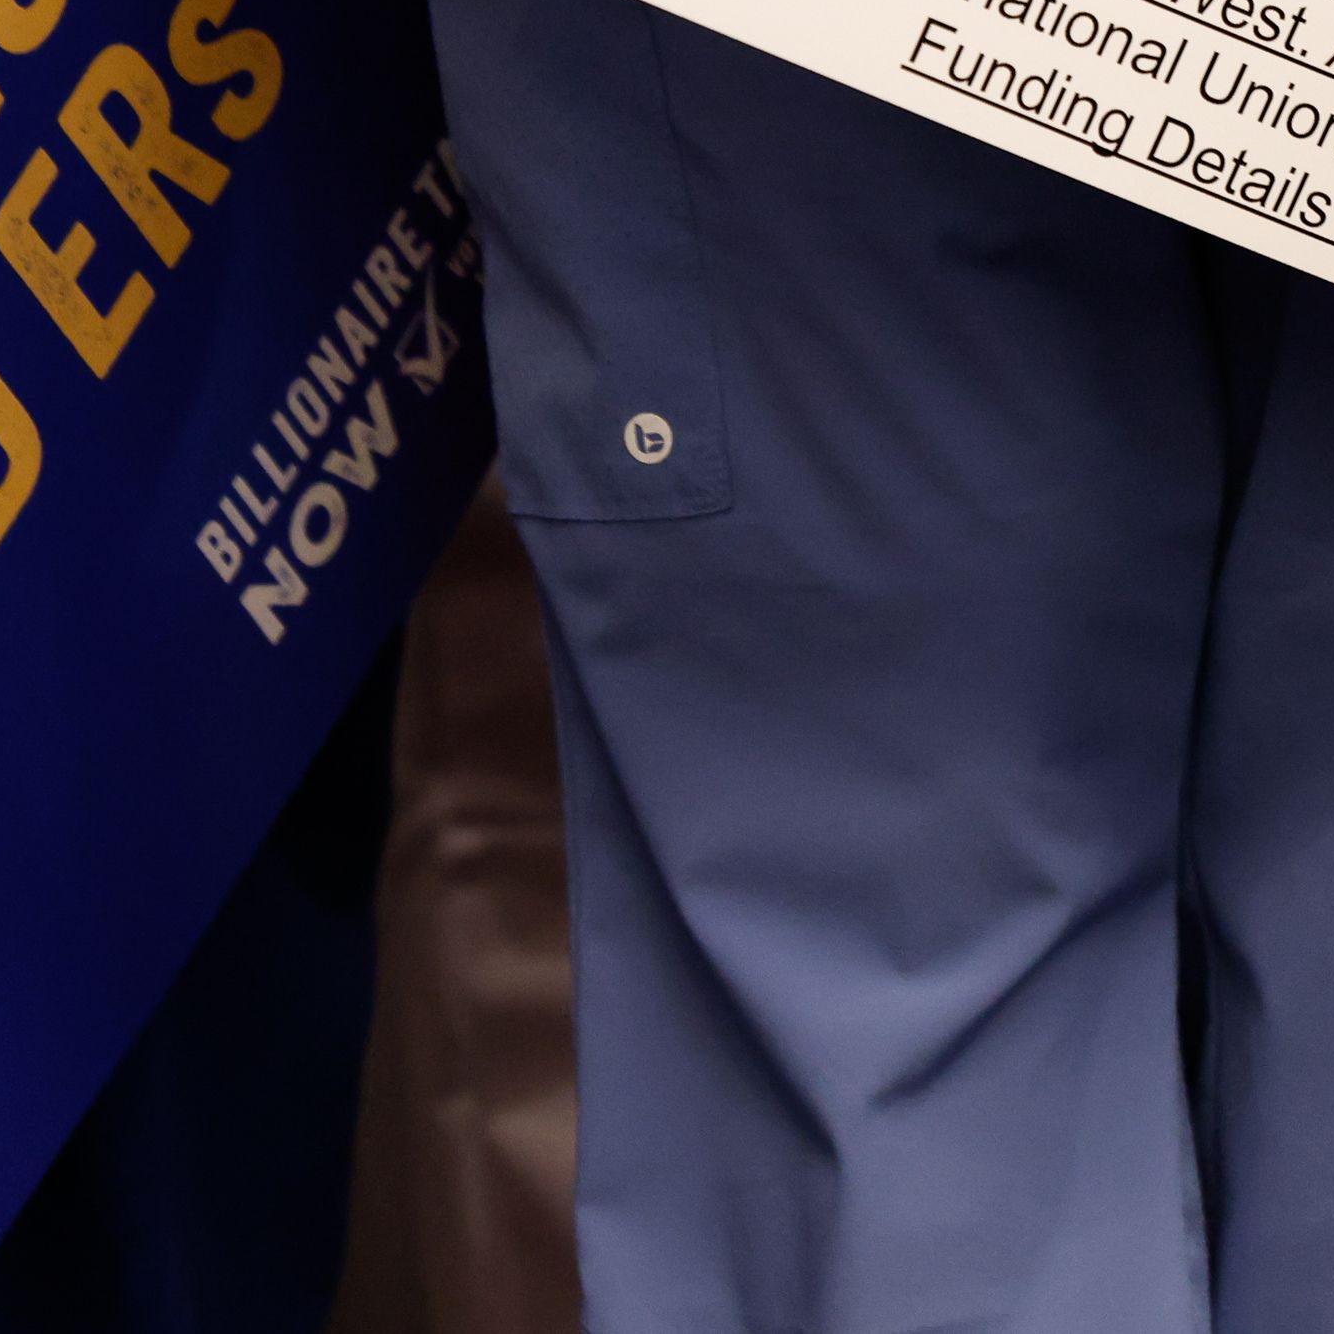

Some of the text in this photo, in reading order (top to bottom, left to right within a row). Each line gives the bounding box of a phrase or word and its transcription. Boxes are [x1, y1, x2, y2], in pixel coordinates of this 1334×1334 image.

[909, 18, 1134, 157] Funding
[1148, 115, 1333, 229] Details
[196, 207, 433, 583] BILLIONAIRE
[240, 379, 399, 646] NOW
